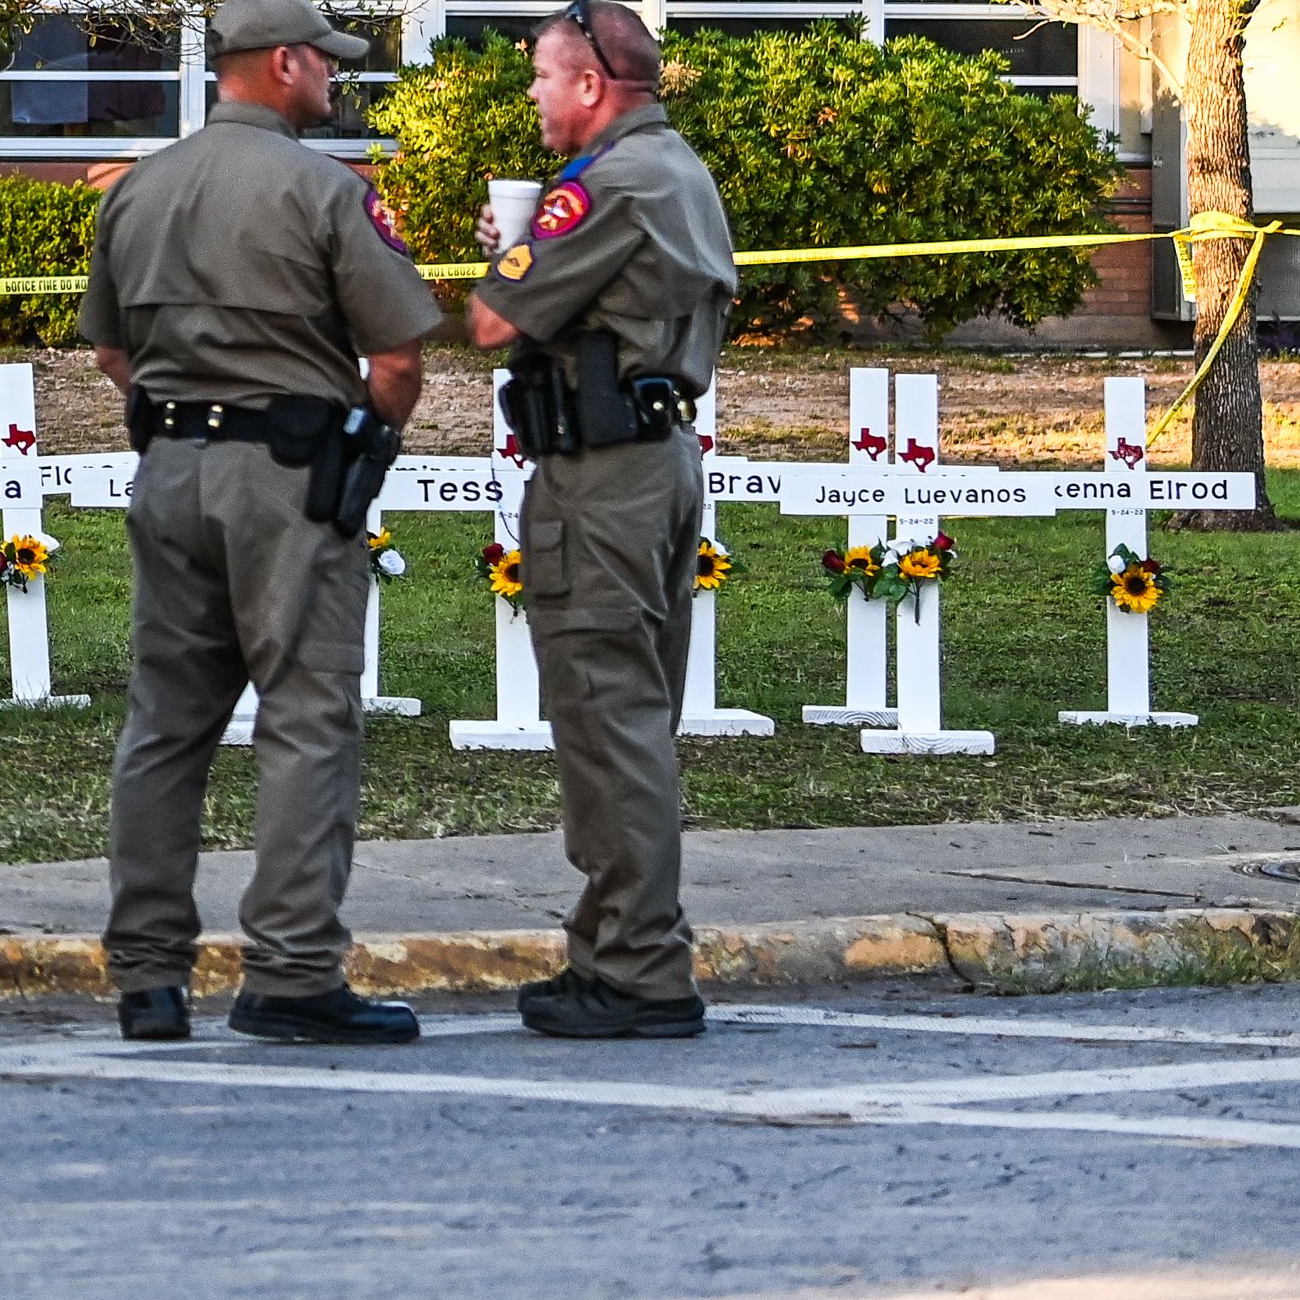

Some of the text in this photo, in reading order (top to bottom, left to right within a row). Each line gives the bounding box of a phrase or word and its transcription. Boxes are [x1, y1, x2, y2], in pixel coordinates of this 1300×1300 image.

[417, 479, 503, 502] Tess
[815, 485, 1027, 507] Jayce Luevanos
[1149, 478, 1228, 501] Elrod
[899, 517, 934, 525] 5-24-22
